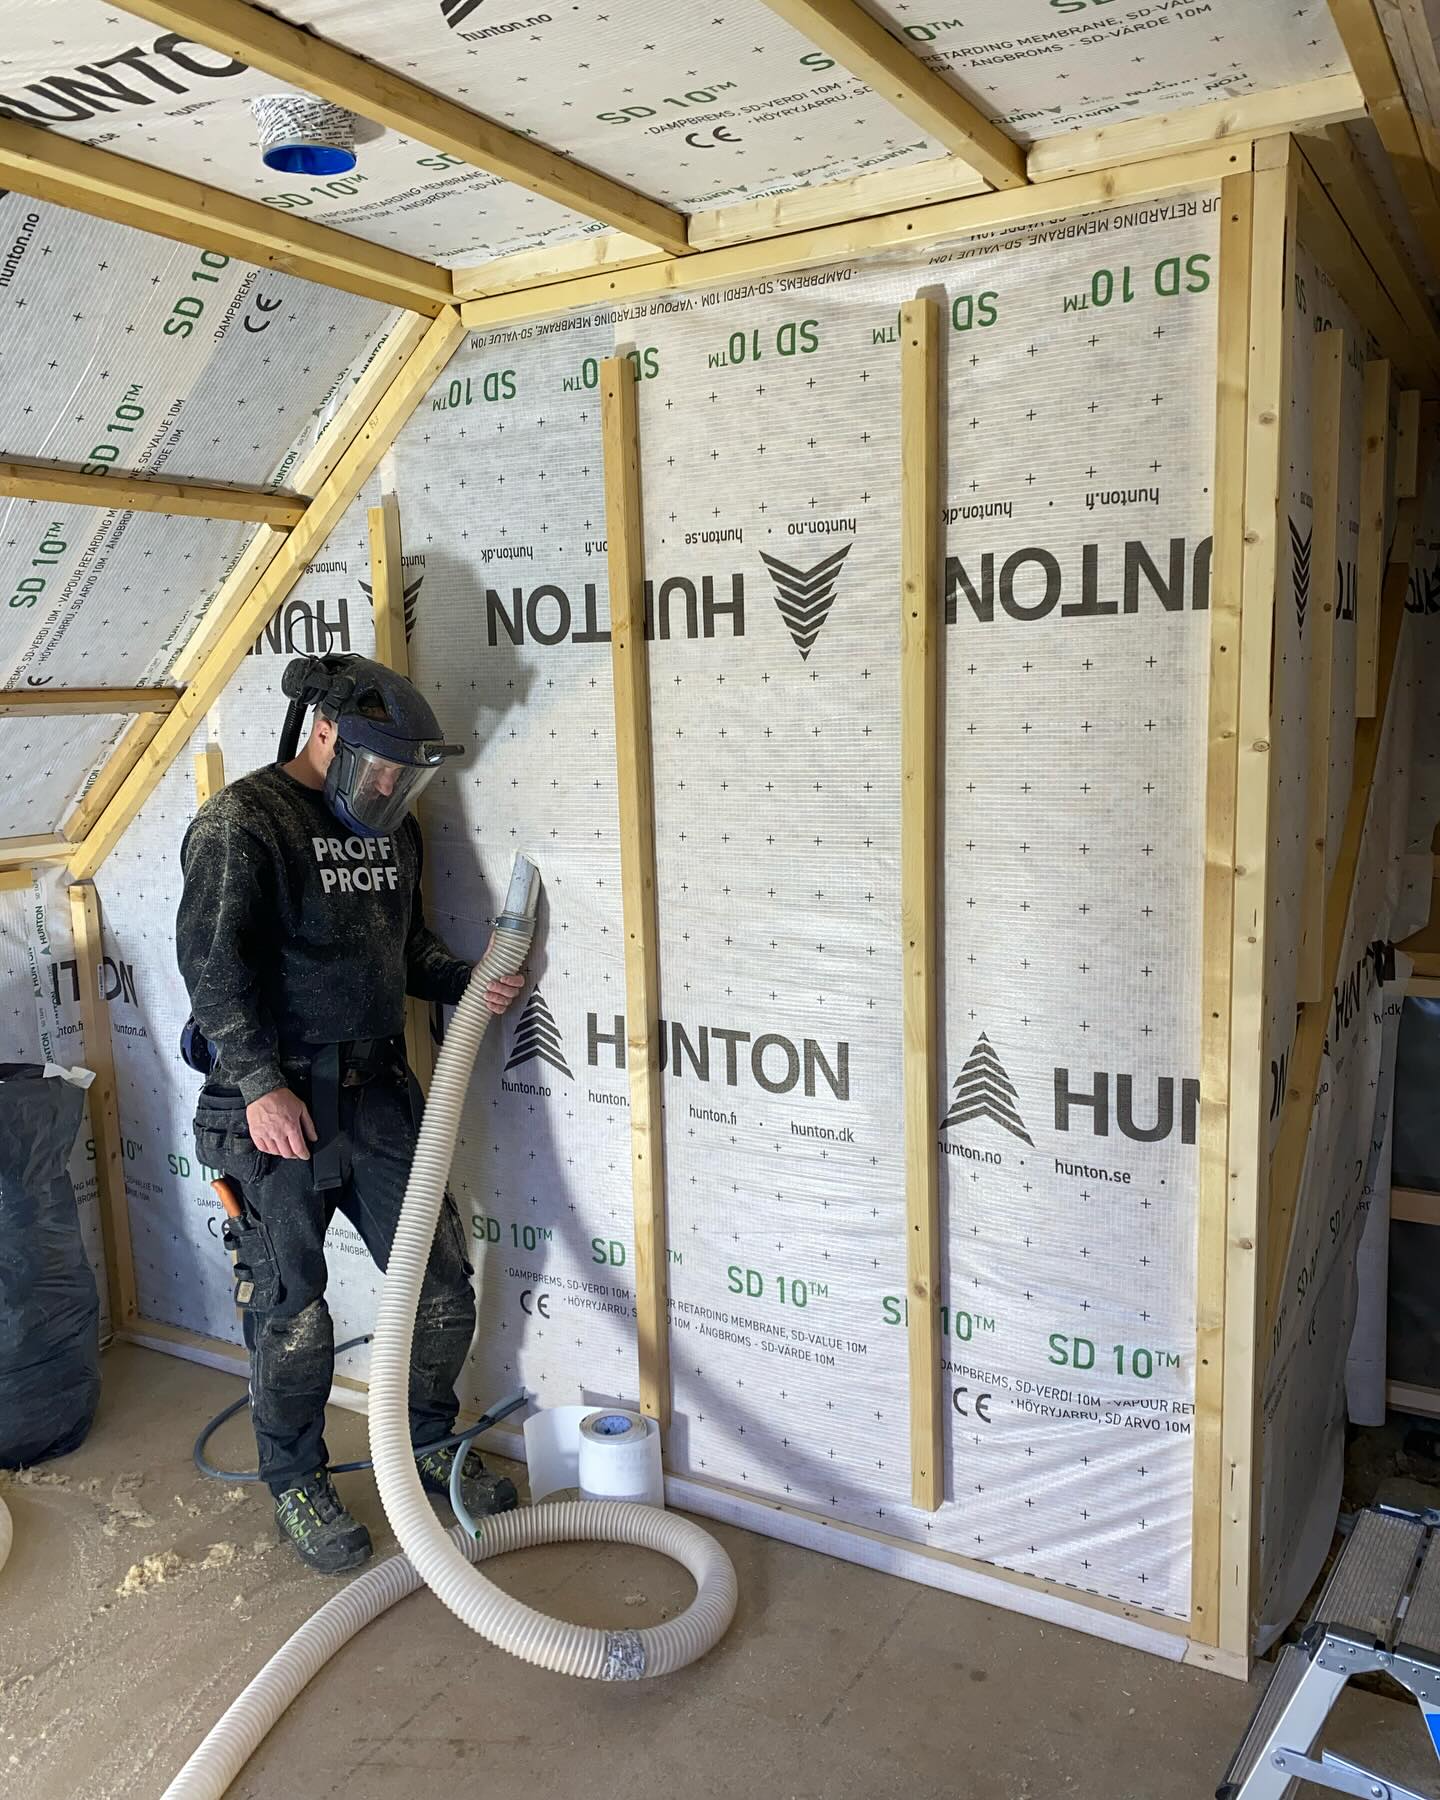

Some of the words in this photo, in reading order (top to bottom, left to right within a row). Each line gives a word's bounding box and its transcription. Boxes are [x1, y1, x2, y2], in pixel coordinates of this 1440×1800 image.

[457, 13, 553, 42] hunton.no
[903, 19, 964, 41] 0™
[1080, 16, 1171, 46] SD-VÄRDE
[1176, 4, 1213, 20] 10M
[921, 41, 1013, 64] RETARDING
[1017, 17, 1123, 46] MEMBRANE,
[597, 106, 657, 125] SD
[649, 110, 742, 135] DAMPBREMS,
[740, 92, 809, 114] SD-VERDI
[810, 82, 842, 96] 10M
[990, 110, 1045, 125] HUNTO
[261, 193, 314, 209] SD
[1113, 198, 1197, 231] RETARDING
[1027, 217, 1109, 247] MEMBRANE,
[929, 254, 953, 266] 10M
[775, 268, 852, 294] DAMPBREMS,
[1155, 253, 1211, 297] SD
[701, 293, 721, 308] 10M
[724, 278, 774, 303] SD-VERDI
[163, 296, 204, 339] SD
[593, 306, 647, 327] RETARDING
[651, 297, 694, 316] VAPOUR
[952, 291, 999, 331] SD
[488, 327, 534, 346] SD-VALUE
[536, 317, 592, 338] MEMBRANE,
[775, 319, 819, 357] SD
[470, 336, 487, 349] 10M
[483, 369, 517, 401] SD
[138, 419, 173, 464] SD-VALUE
[167, 399, 185, 417] 10M
[167, 429, 185, 446] 10M
[80, 444, 120, 477] SD
[271, 451, 298, 488] HUNTON
[1086, 487, 1160, 510] hunton.fi
[787, 518, 857, 535] hunton.no
[942, 501, 1013, 525] hunton.dk
[685, 528, 743, 544] hunton.se
[305, 561, 347, 575] hunton.se
[481, 545, 533, 564] hunton.dk
[45, 609, 61, 625] 10M
[59, 568, 86, 604] VAPOUR
[81, 519, 113, 569] RETARDING
[71, 598, 84, 611] SD
[79, 575, 98, 598] ARVO
[92, 557, 109, 573] 10M
[9, 577, 46, 608] SD
[486, 573, 745, 647] HUTON
[312, 836, 391, 862] PROFF
[320, 867, 398, 893] PROFF
[35, 905, 48, 945] HUNTON
[587, 1012, 850, 1101] HNTON
[501, 1078, 551, 1098] hunton.no
[588, 1089, 630, 1107] hunton.
[689, 1104, 737, 1126] hunton.fi
[791, 1120, 855, 1143] hunton.dk
[168, 1154, 190, 1178] SD
[1054, 1159, 1131, 1185] hunton.se
[327, 1227, 361, 1241] ETARDING
[471, 1215, 500, 1243] SD
[592, 1238, 626, 1267] SD
[727, 1265, 763, 1298] SD
[509, 1268, 565, 1289] DAMPBREMS,
[567, 1280, 609, 1298] SD-VERDI
[611, 1287, 630, 1299] 10M
[677, 1301, 729, 1324] RETARDING
[731, 1314, 789, 1341] MEMBRANE,
[791, 1328, 843, 1350] SD-VALUE
[846, 1341, 867, 1355] 10M
[674, 1316, 691, 1331] 10M
[761, 1340, 812, 1362] SD-VÄRDE
[815, 1353, 835, 1366] 10M
[1048, 1333, 1095, 1370] SD
[1015, 1379, 1073, 1402] SD-VERDI
[1077, 1392, 1101, 1407] 10M
[1105, 1412, 1122, 1426] SD
[1125, 1417, 1161, 1431] ARVO
[1165, 1421, 1191, 1434] 10M
